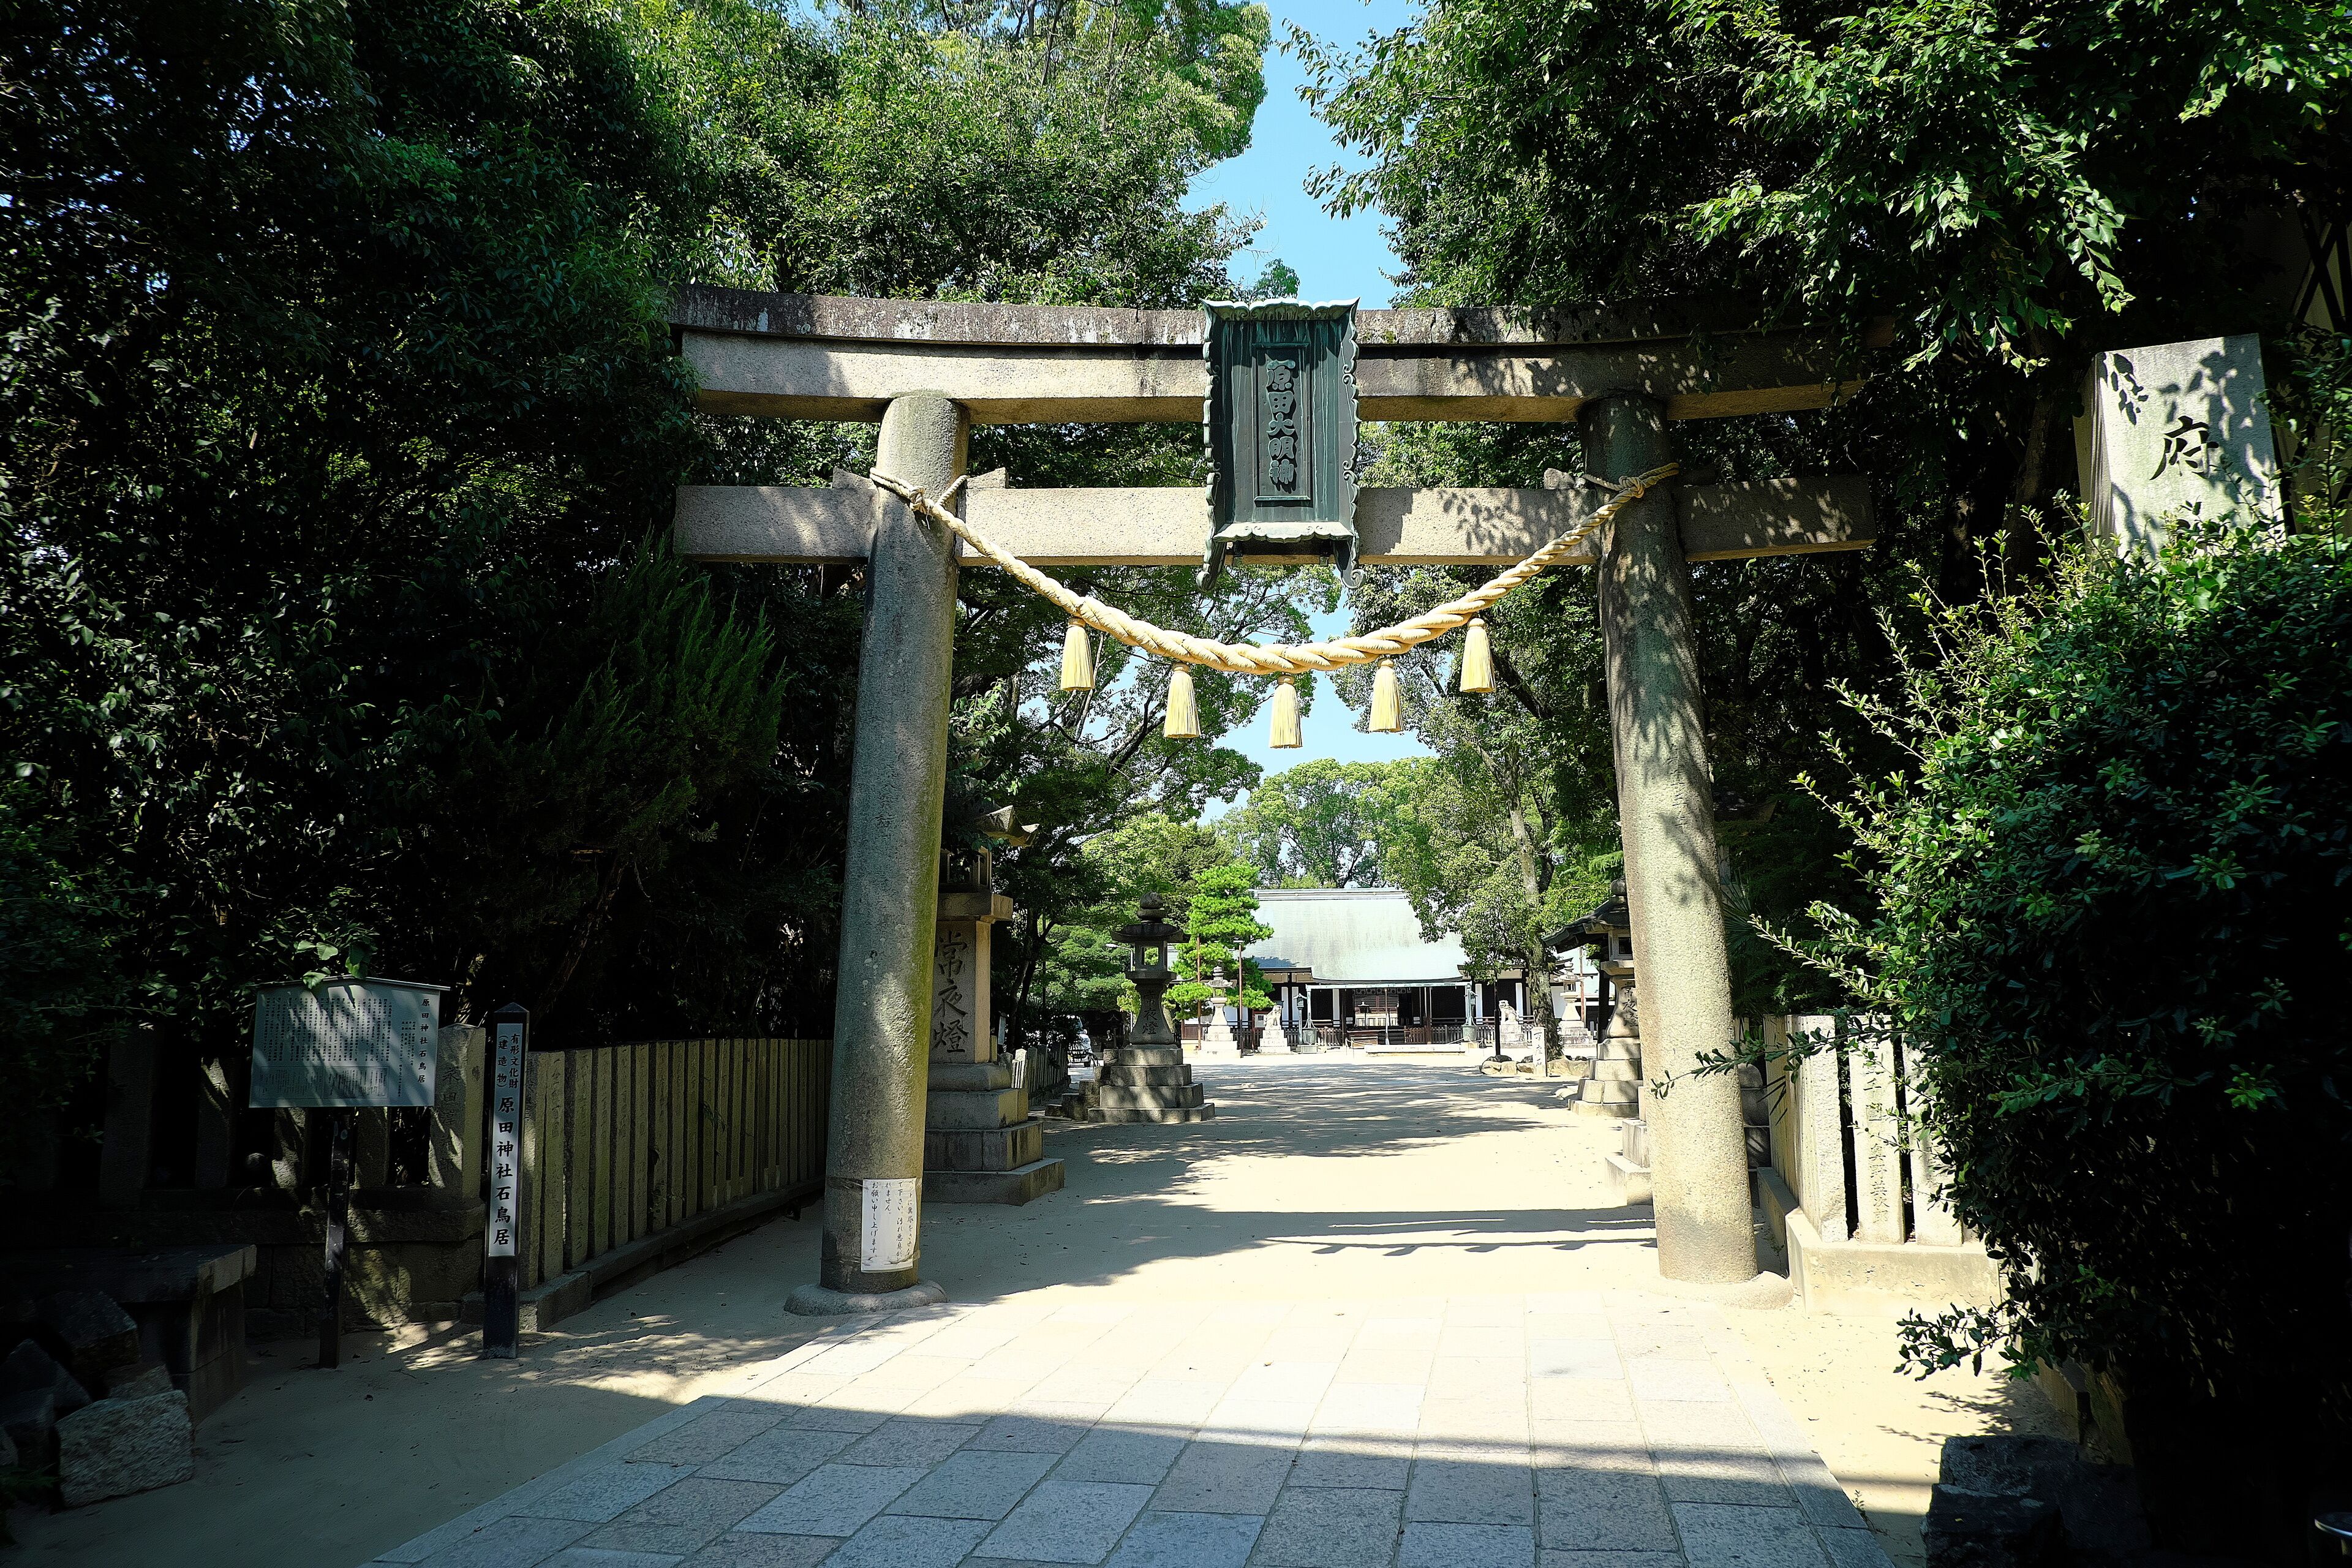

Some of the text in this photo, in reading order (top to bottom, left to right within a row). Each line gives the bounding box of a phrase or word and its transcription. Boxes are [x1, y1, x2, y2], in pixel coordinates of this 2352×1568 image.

[2149, 415, 2219, 480] 府
[932, 930, 969, 1054] 常夜燈
[1142, 990, 1159, 1035] 常夜燈
[417, 998, 431, 1084] 原田神社石鳥居
[508, 1033, 520, 1089] 有形文化財
[493, 1096, 514, 1245] 原田神社石鳥居
[870, 1182, 879, 1257] お願い申し上げます。
